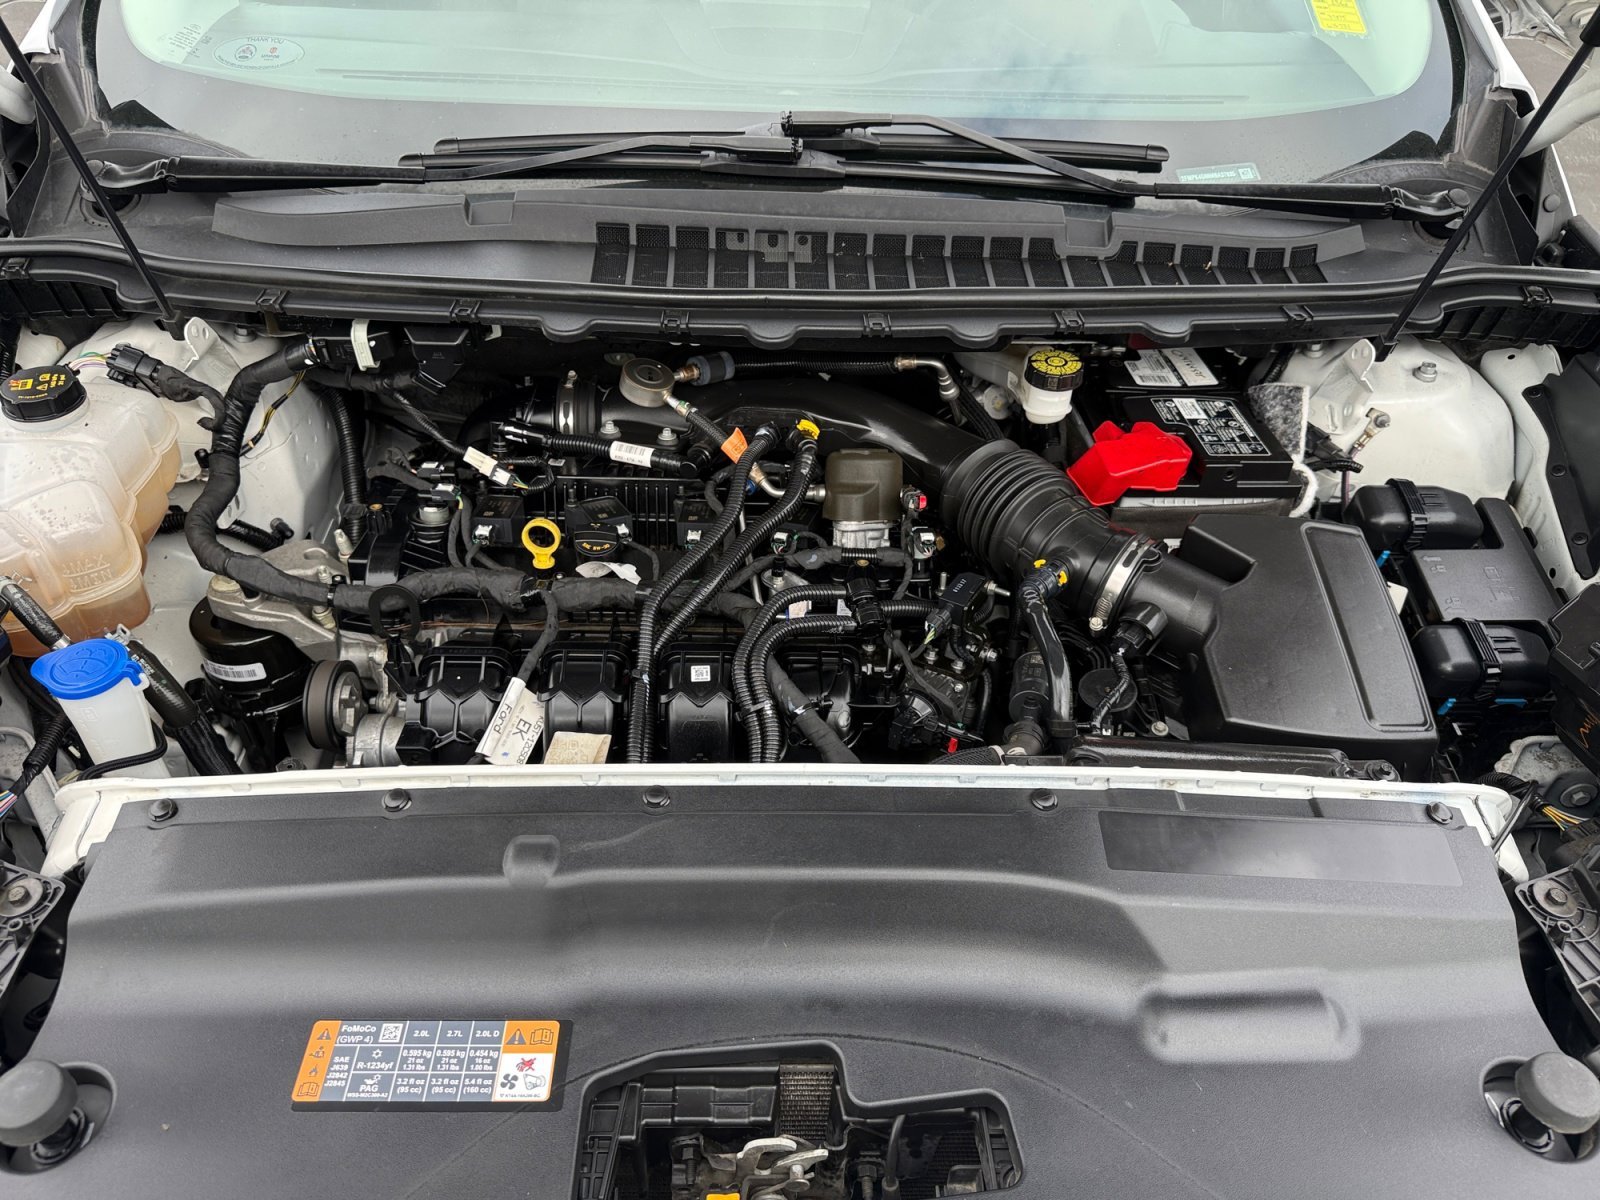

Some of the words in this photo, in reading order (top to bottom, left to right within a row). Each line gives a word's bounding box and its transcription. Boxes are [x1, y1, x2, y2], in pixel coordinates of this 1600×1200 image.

[270, 37, 285, 45] YOU
[79, 569, 113, 589] MIN
[493, 703, 513, 735] Ford
[512, 718, 532, 742] EK
[341, 1024, 377, 1033] FoMoCo
[336, 1035, 363, 1045] (GWP
[363, 1035, 374, 1045] 4)
[402, 1049, 422, 1057] 0.595
[422, 1049, 432, 1059] kg
[436, 1049, 455, 1057] 0.595
[456, 1049, 466, 1059] kg
[469, 1049, 489, 1057] 0.454
[489, 1049, 499, 1059] kg
[356, 1061, 394, 1071] R-1234yf
[359, 1084, 379, 1092] PAG
[397, 1086, 409, 1094] (95
[409, 1086, 422, 1094] cc)
[431, 1086, 443, 1094] (95
[444, 1086, 456, 1094] cc)
[463, 1086, 479, 1094] (160
[480, 1086, 492, 1094] cc)
